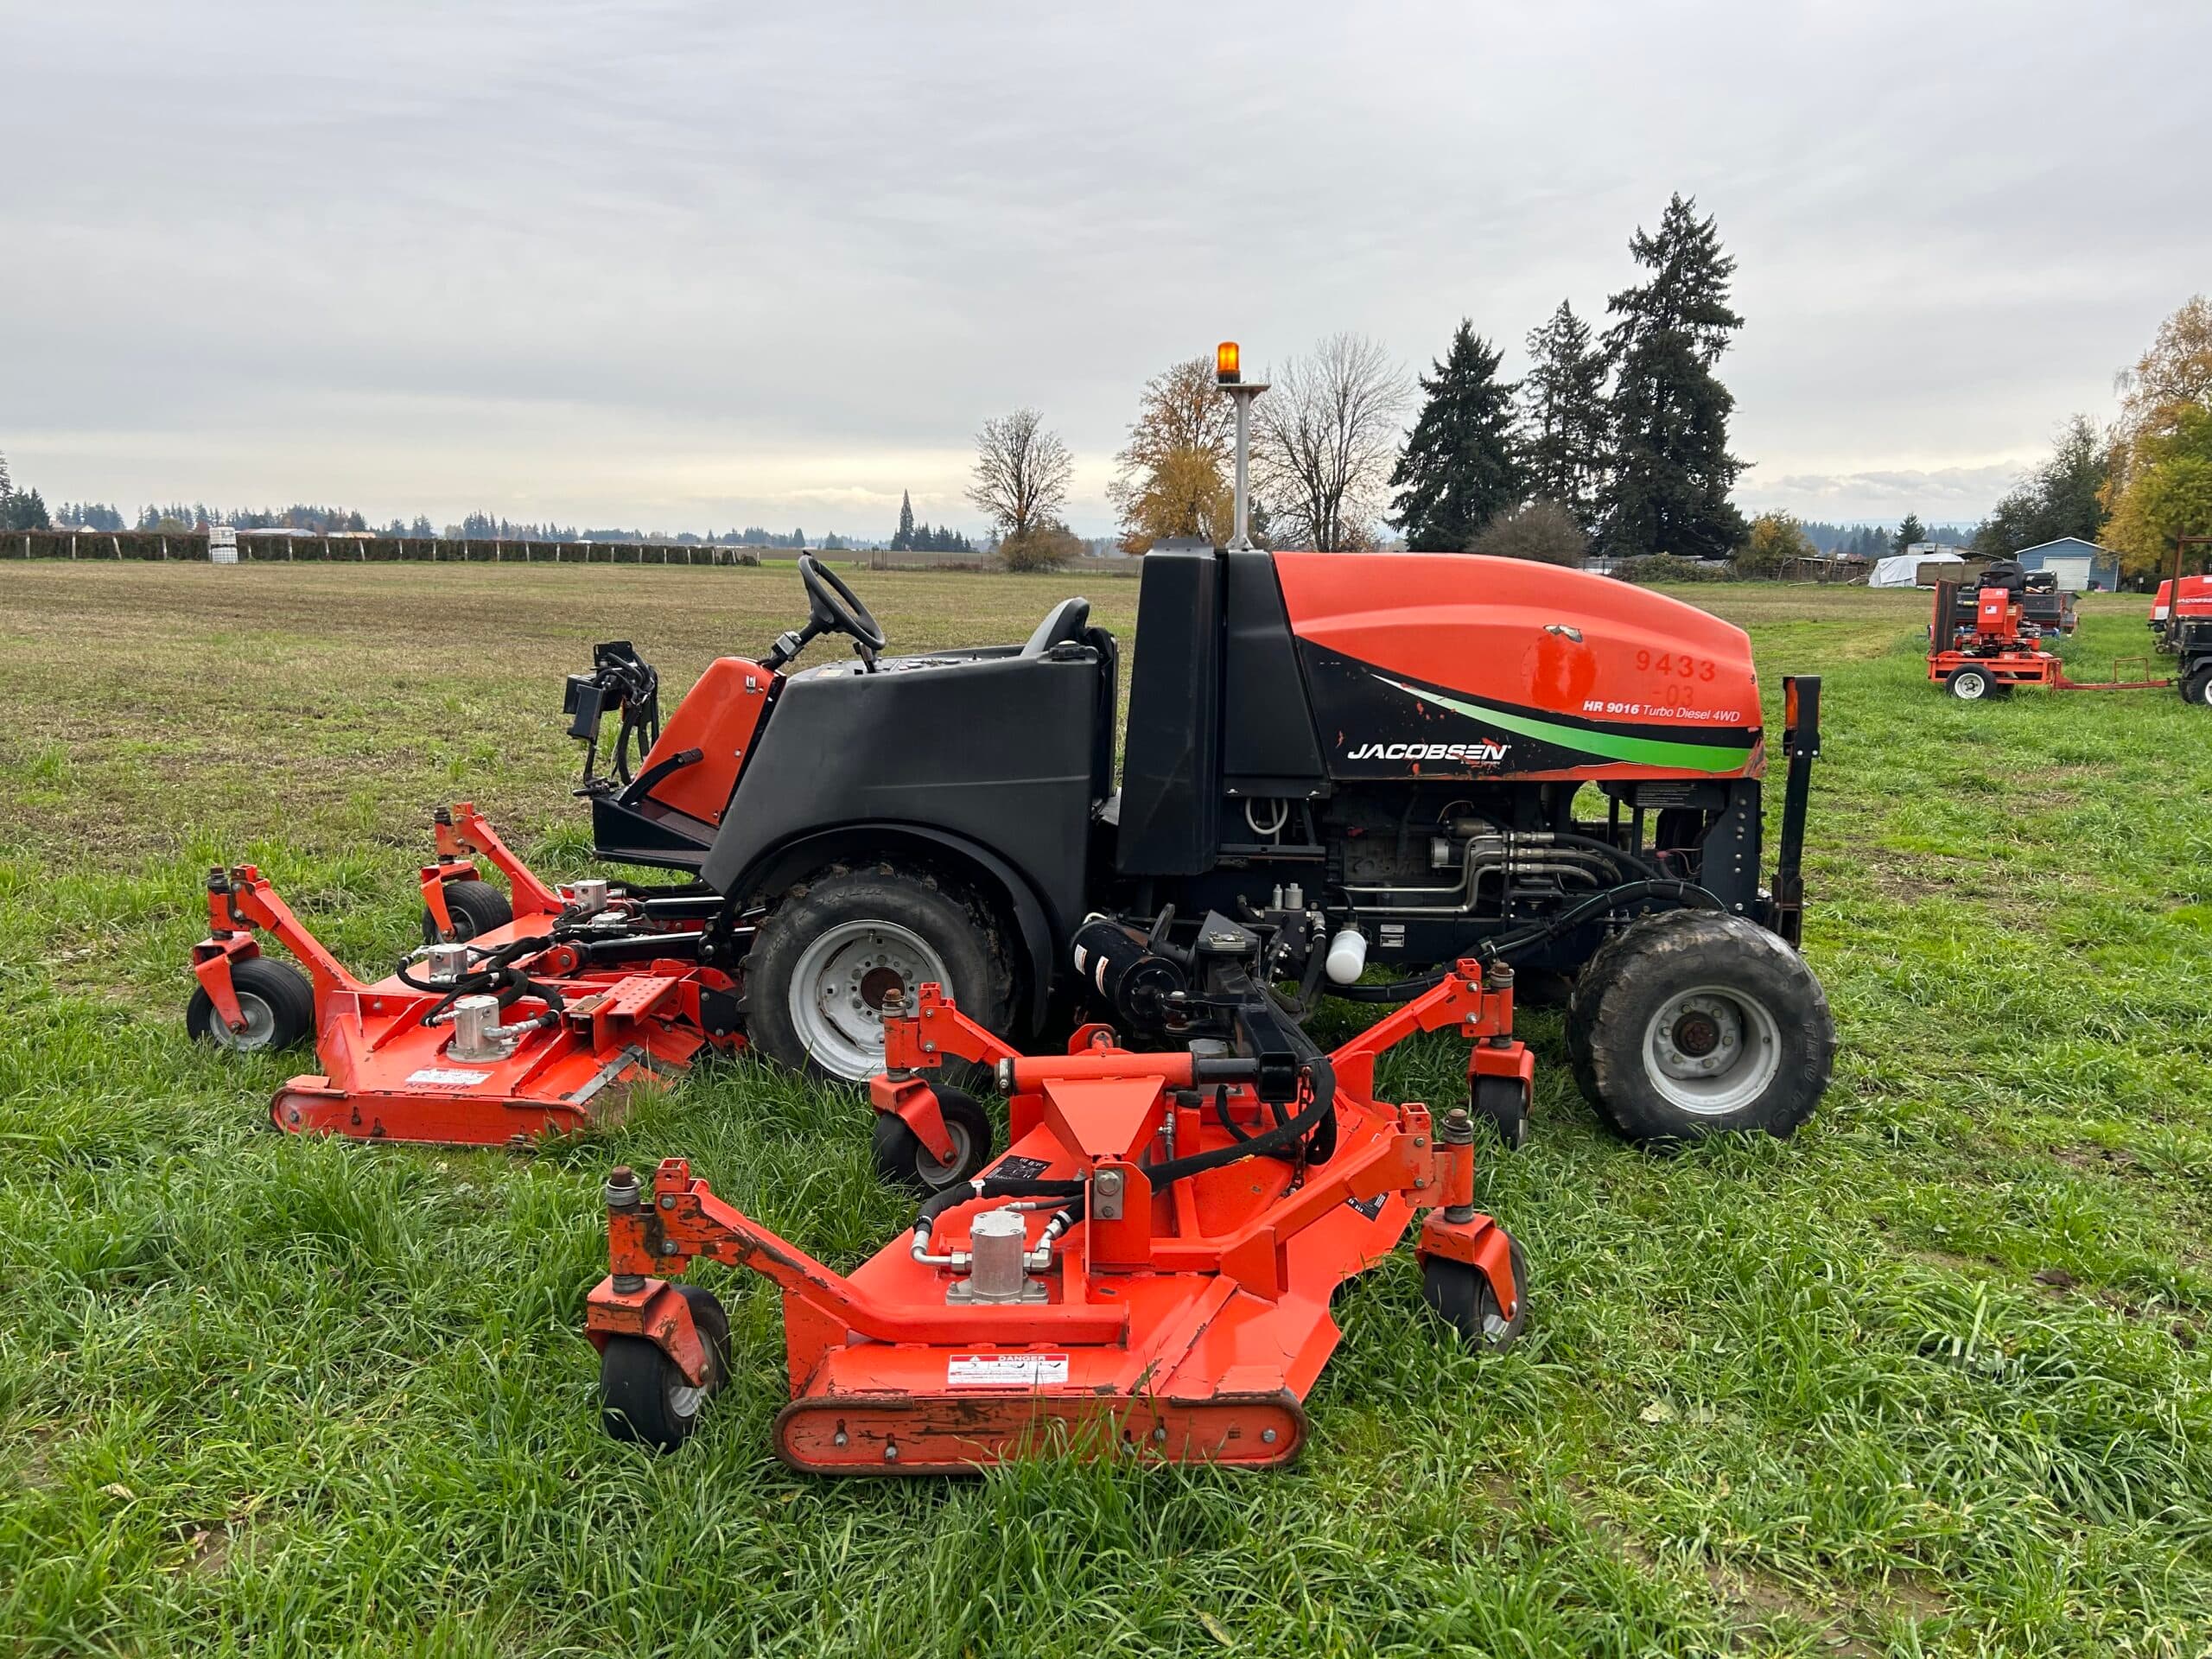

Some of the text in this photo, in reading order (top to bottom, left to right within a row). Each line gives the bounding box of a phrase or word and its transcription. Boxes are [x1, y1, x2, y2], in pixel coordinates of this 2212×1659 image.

[1636, 650, 1715, 682] 9433
[1583, 700, 1741, 722] HR 9016 Turbo Diesel 4WD
[1347, 744, 1509, 760] JACOBSEN
